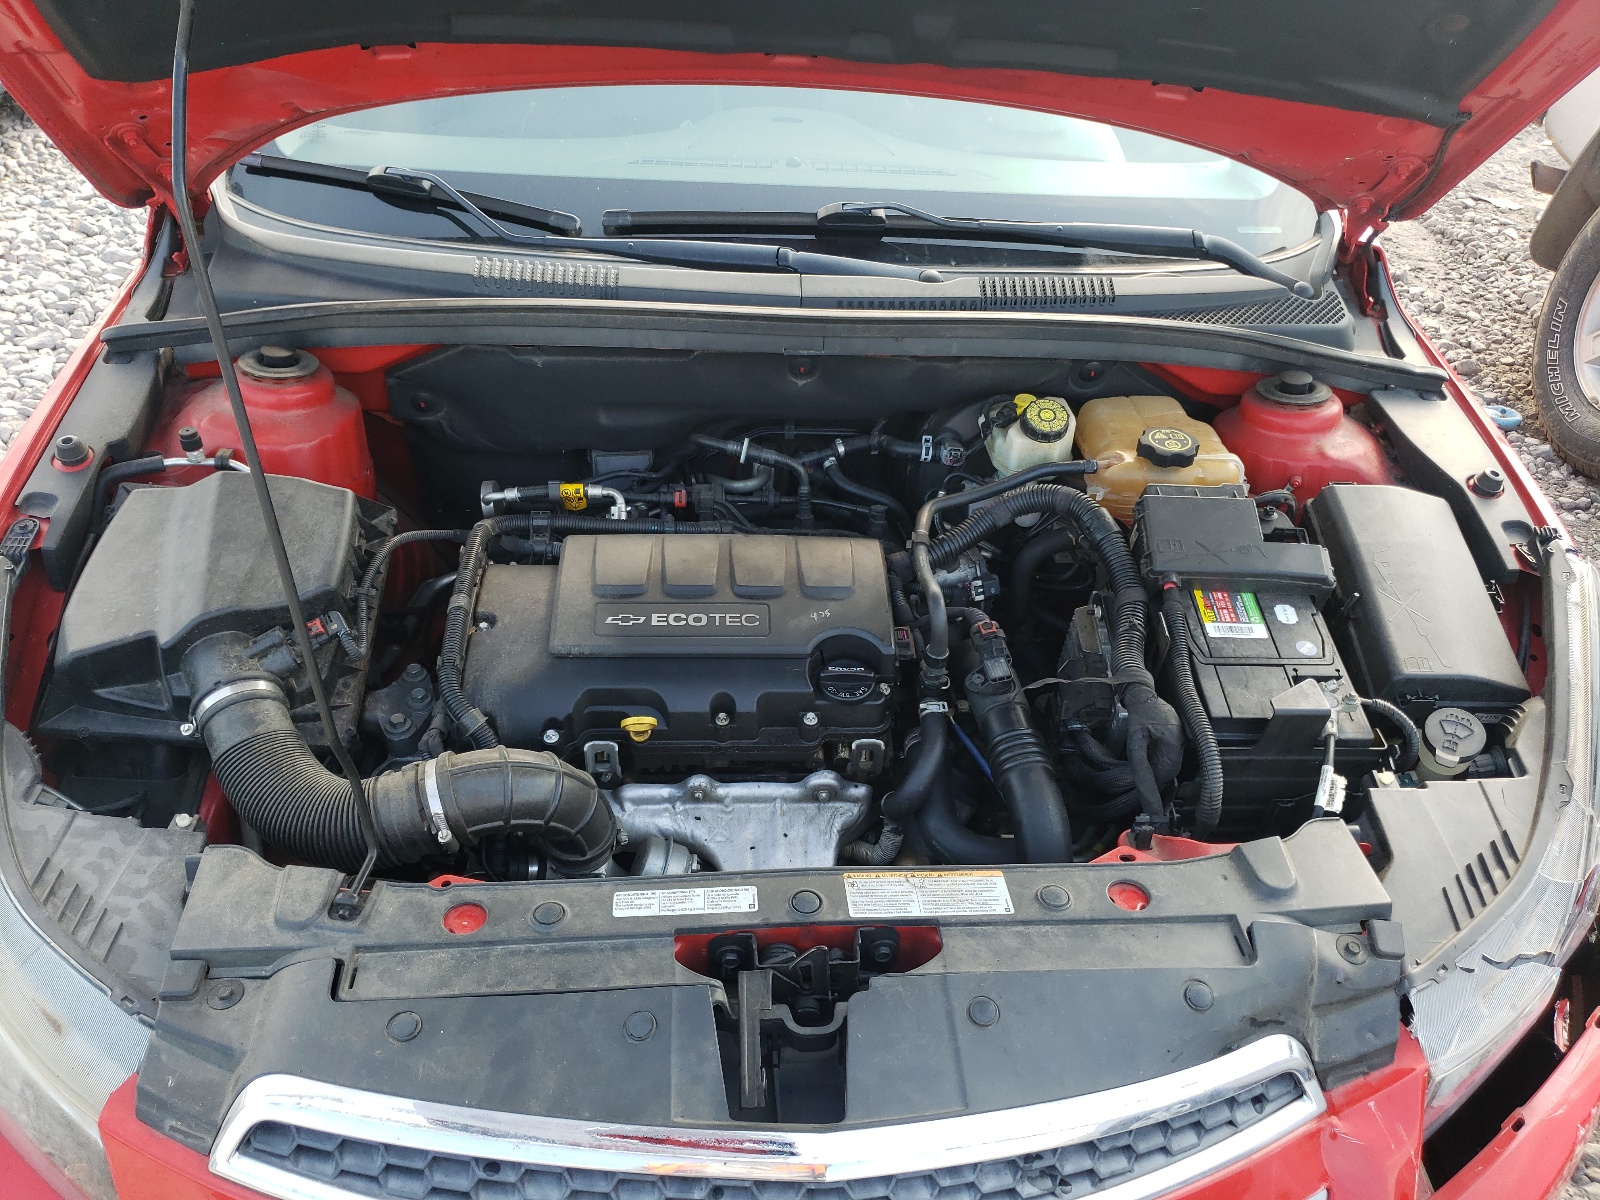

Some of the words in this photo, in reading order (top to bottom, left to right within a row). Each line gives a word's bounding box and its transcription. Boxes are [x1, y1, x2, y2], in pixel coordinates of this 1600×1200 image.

[1546, 298, 1581, 423] MICHELIN
[651, 613, 760, 626] ECOTEC
[853, 686, 868, 697] SAE
